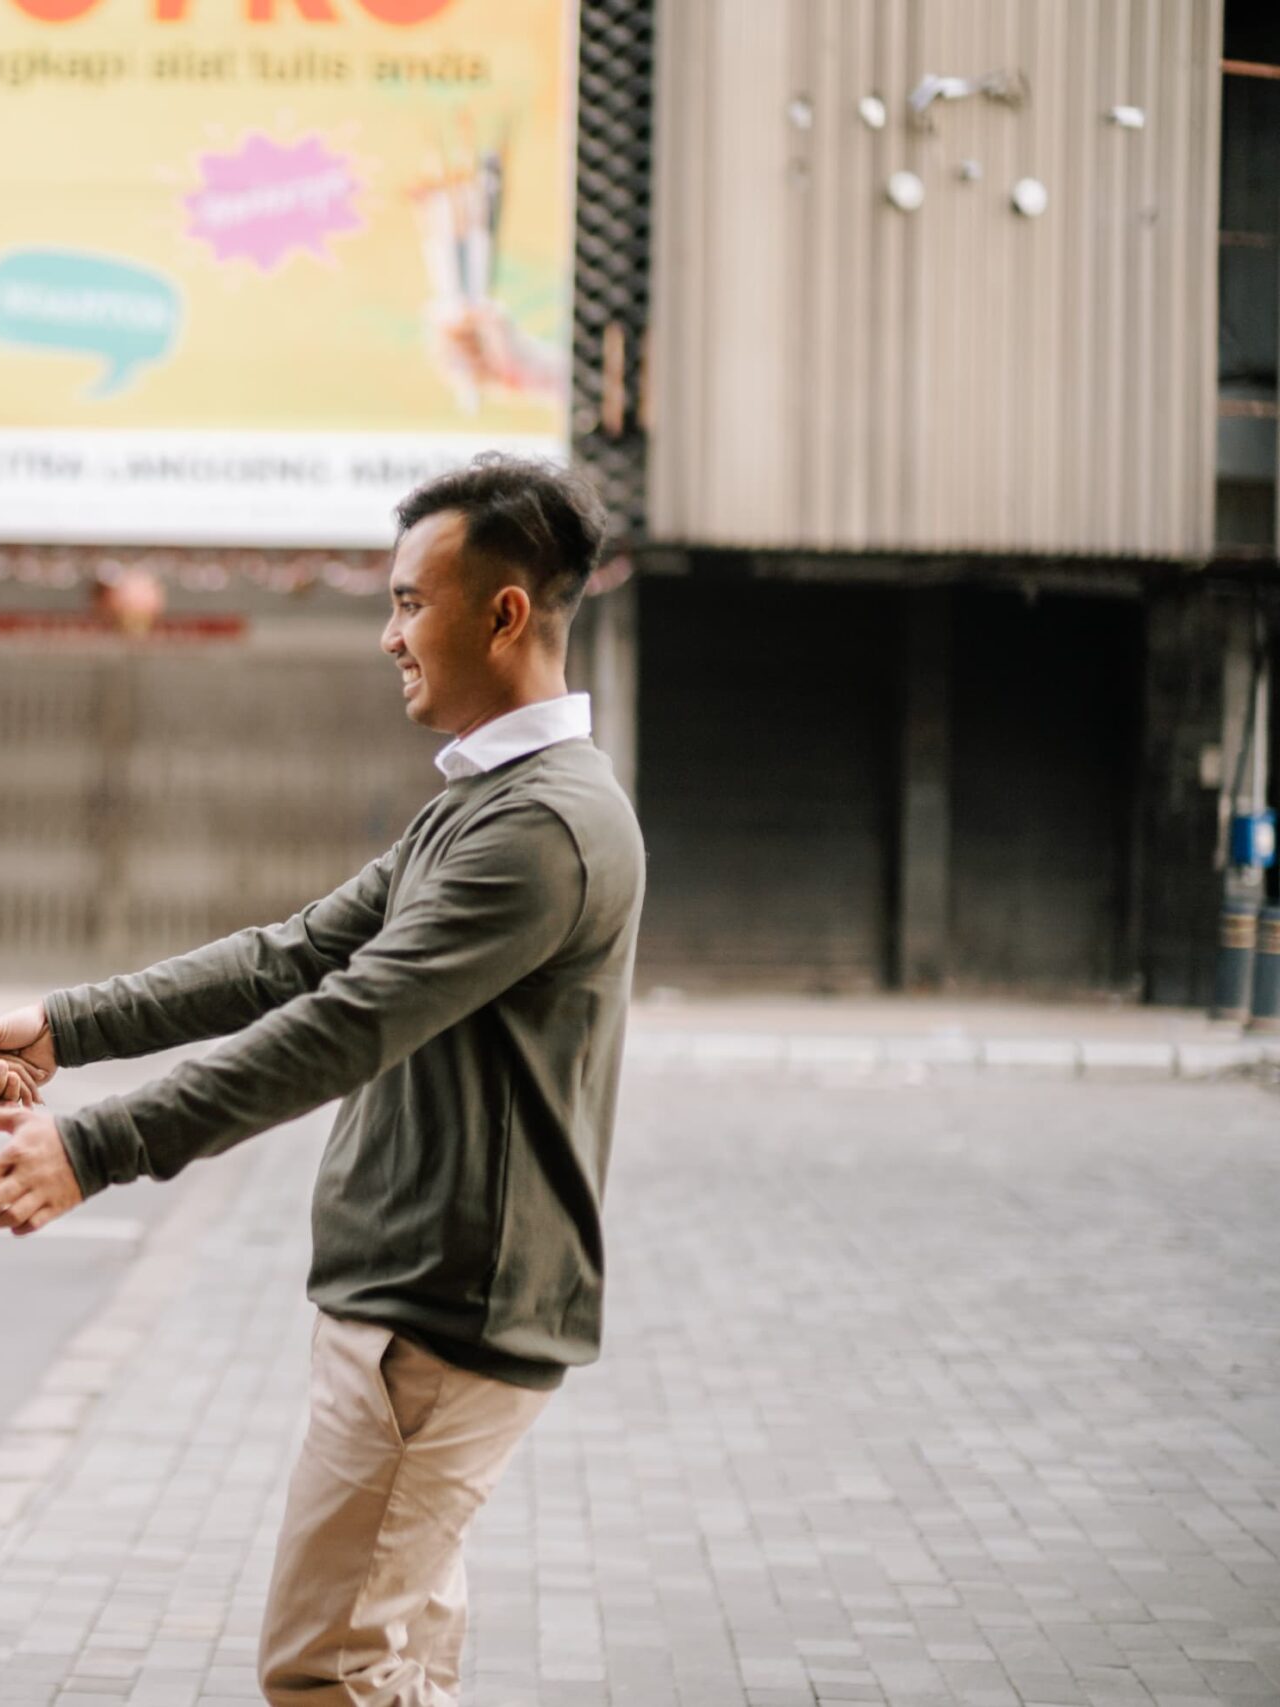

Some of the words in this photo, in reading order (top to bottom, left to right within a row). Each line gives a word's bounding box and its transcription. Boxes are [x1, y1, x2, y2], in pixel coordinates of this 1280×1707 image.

[149, 45, 233, 80] alat
[250, 45, 352, 80] tulis
[367, 46, 489, 82] anda
